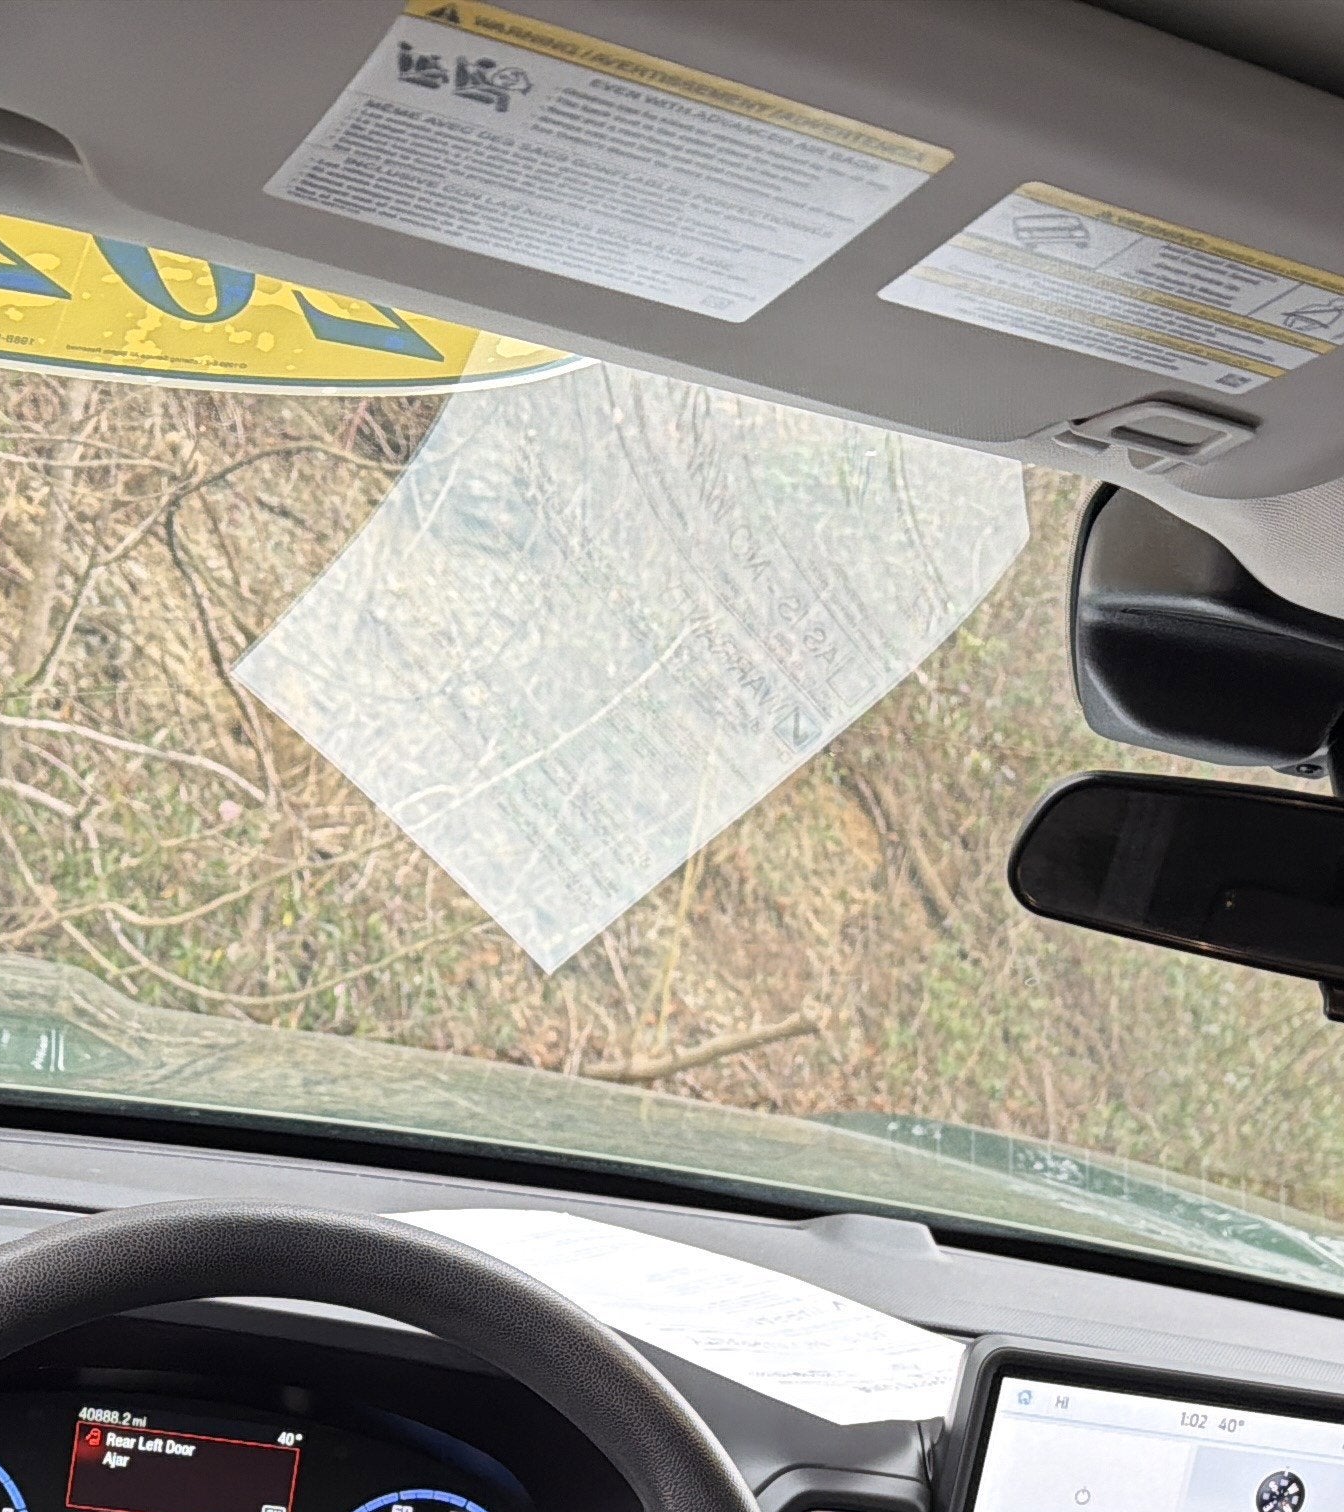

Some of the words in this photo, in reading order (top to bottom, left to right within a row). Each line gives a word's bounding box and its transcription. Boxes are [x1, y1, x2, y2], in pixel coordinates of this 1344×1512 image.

[78, 1407, 131, 1426] 40888.2
[132, 1417, 146, 1428] mi
[1180, 1411, 1208, 1429] 1:02
[1217, 1417, 1245, 1433] 40°
[106, 1432, 136, 1450] Rear
[138, 1436, 163, 1453] Left
[165, 1440, 196, 1457] Door
[277, 1431, 303, 1447] 40°
[102, 1451, 130, 1469] Ajar
